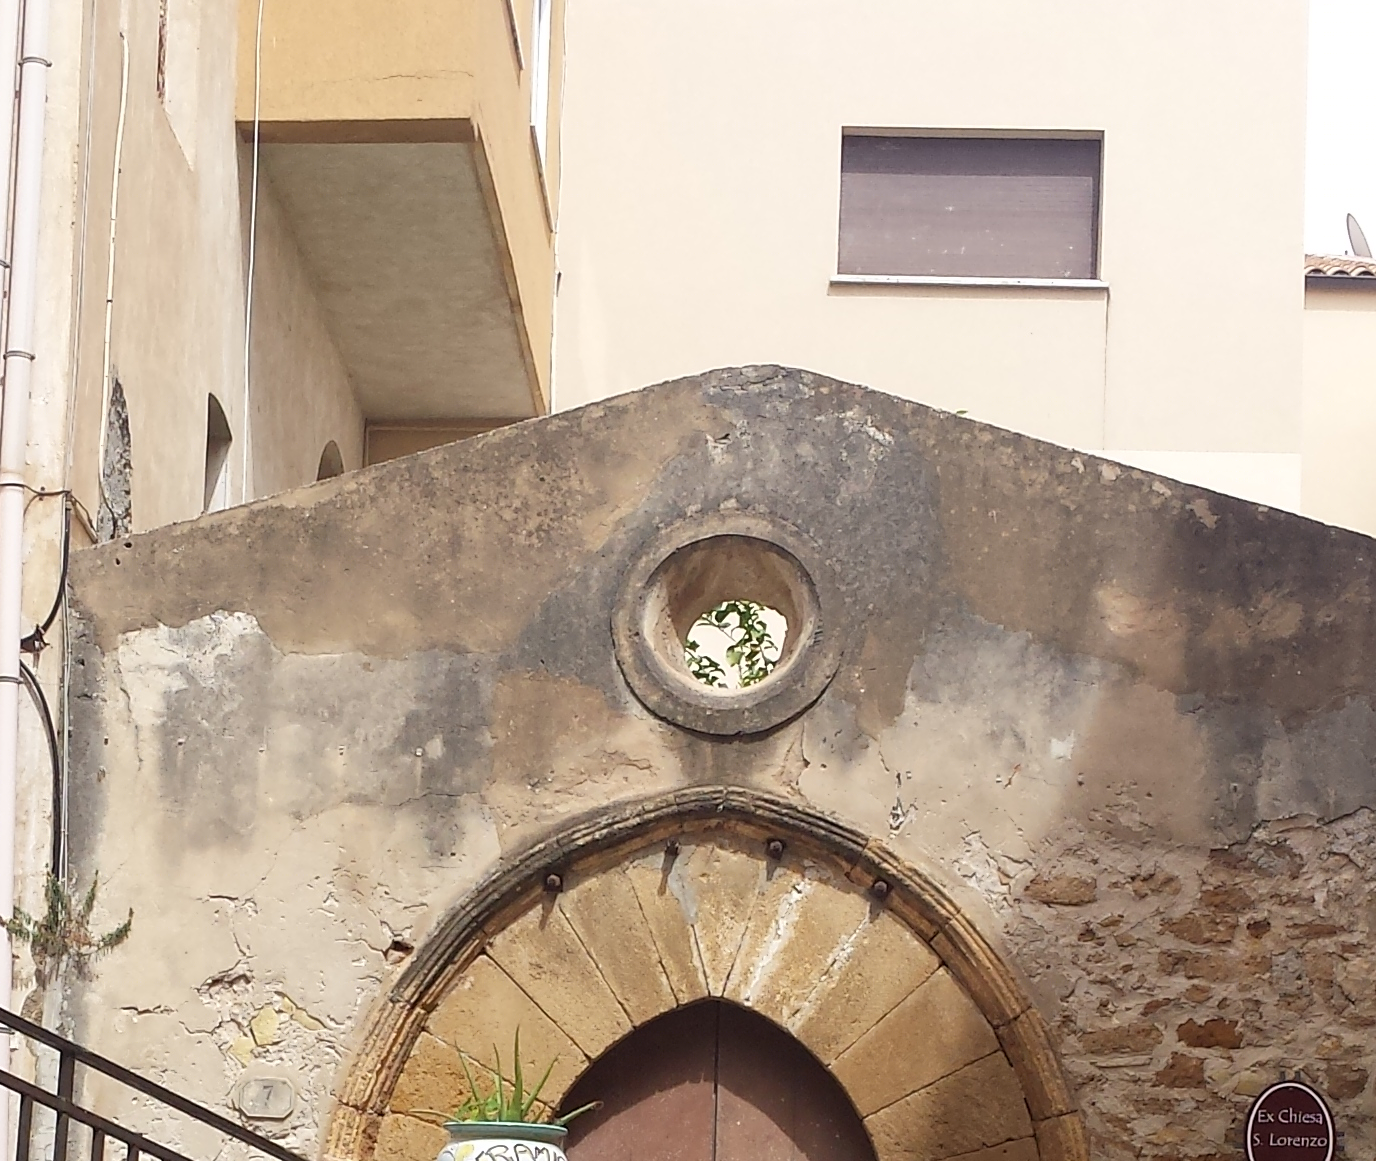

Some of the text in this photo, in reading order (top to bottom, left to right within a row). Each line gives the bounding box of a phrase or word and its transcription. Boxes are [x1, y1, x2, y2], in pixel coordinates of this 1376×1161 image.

[263, 1085, 273, 1101] 7
[1257, 1107, 1323, 1125] Ex Chiesa
[1252, 1132, 1328, 1148] S. Lorenzo
